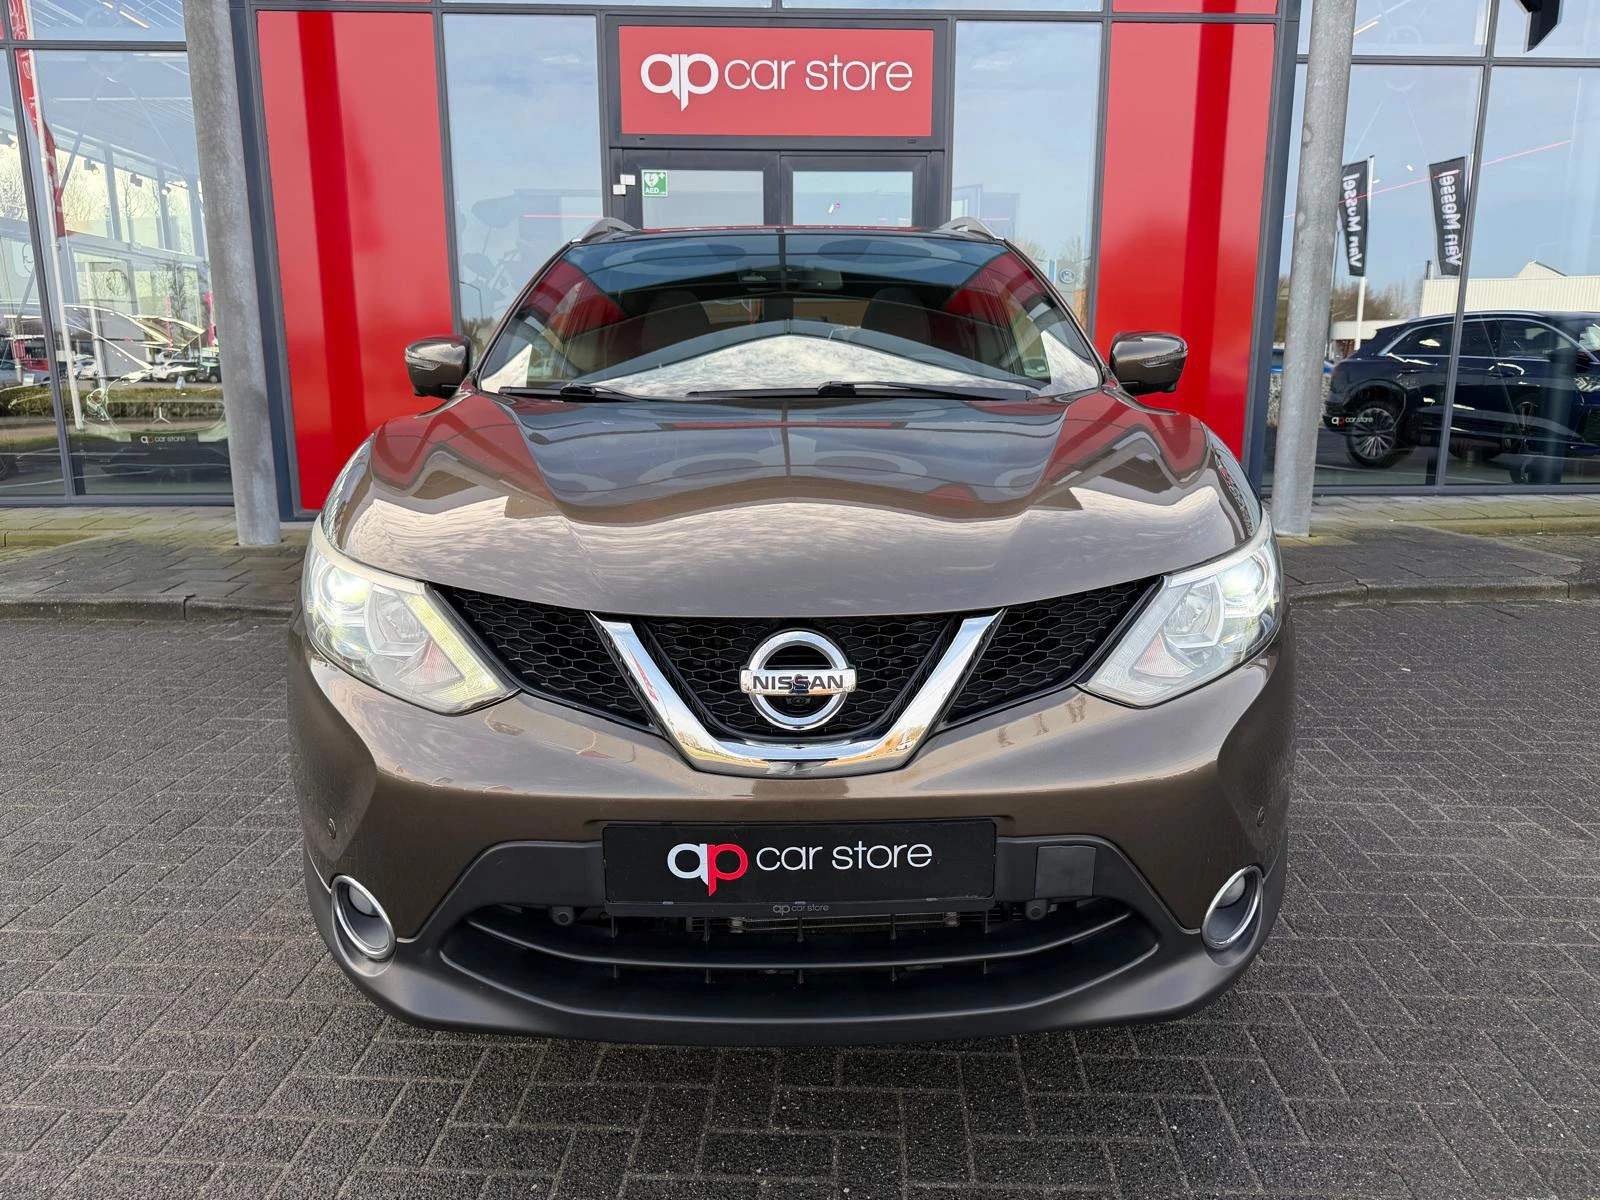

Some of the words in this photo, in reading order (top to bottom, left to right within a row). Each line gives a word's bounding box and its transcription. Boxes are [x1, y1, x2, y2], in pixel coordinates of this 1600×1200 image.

[640, 53, 719, 112] ap
[724, 59, 796, 90] car
[805, 54, 913, 92] store
[752, 674, 844, 690] NISSAN
[666, 843, 749, 896] ap
[756, 846, 823, 871] car
[831, 841, 932, 870] store
[807, 904, 829, 912] store
